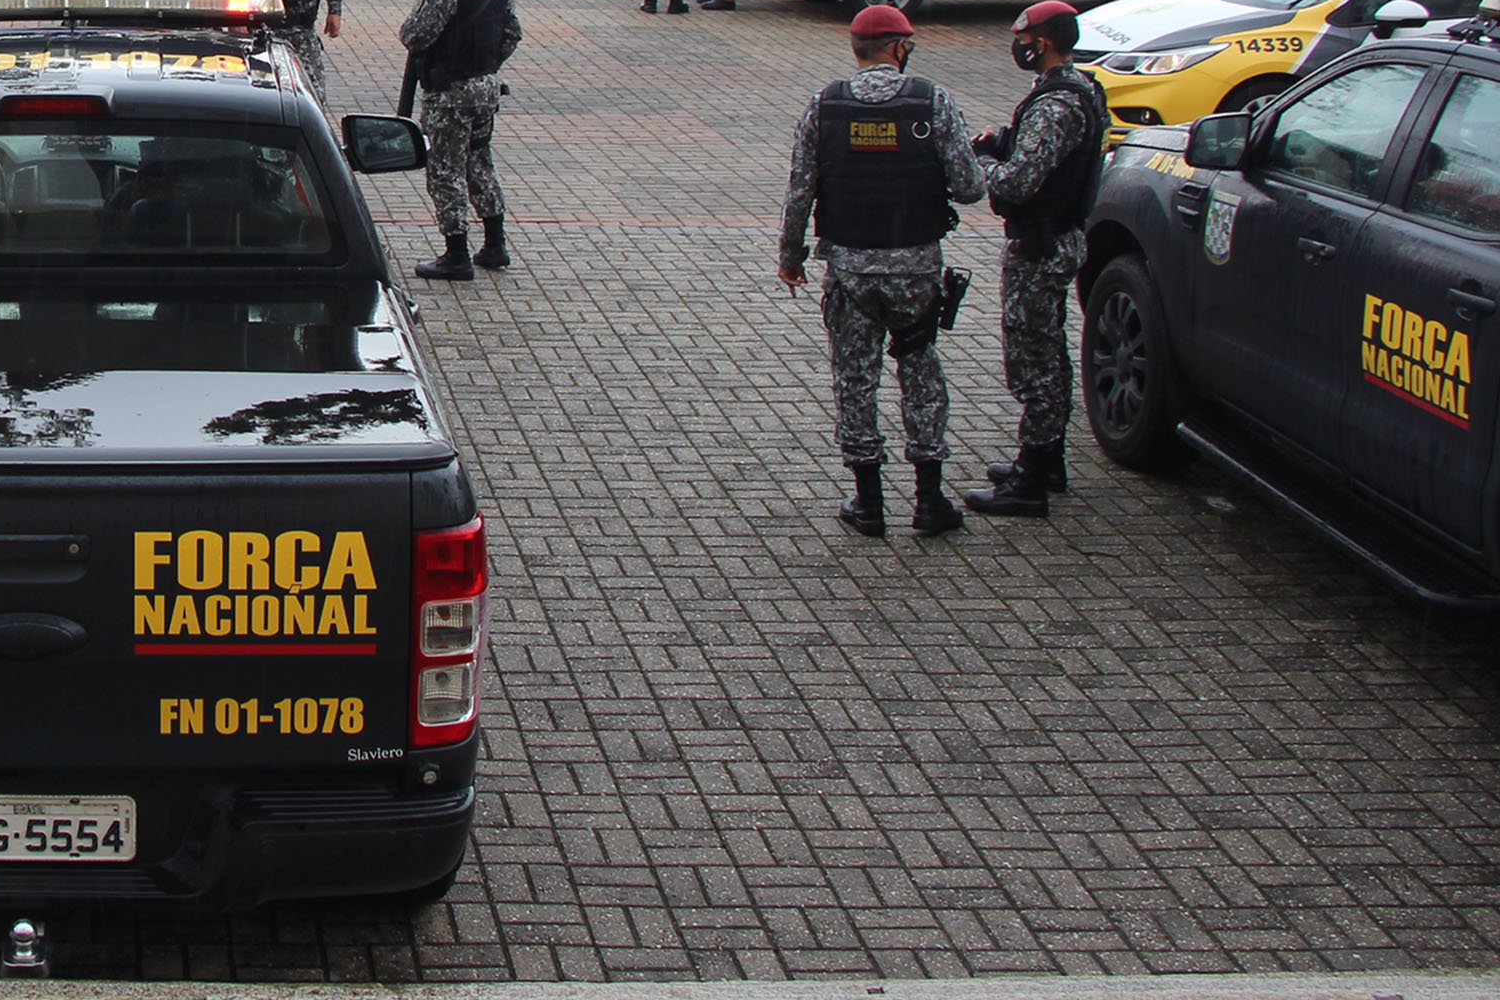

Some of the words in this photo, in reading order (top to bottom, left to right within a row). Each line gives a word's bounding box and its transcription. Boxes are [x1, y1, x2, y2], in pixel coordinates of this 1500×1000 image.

[1235, 37, 1303, 53] 14339
[851, 136, 898, 146] NACIONAL
[1362, 293, 1473, 384] FORÇA
[1361, 341, 1470, 420] NACIONAL
[134, 530, 377, 594] FORÇA
[134, 594, 377, 636] NACIONAL
[159, 697, 204, 735] FN
[214, 697, 364, 735] 01-1078
[347, 746, 404, 762] Slaviero
[13, 804, 47, 815] BRASIL
